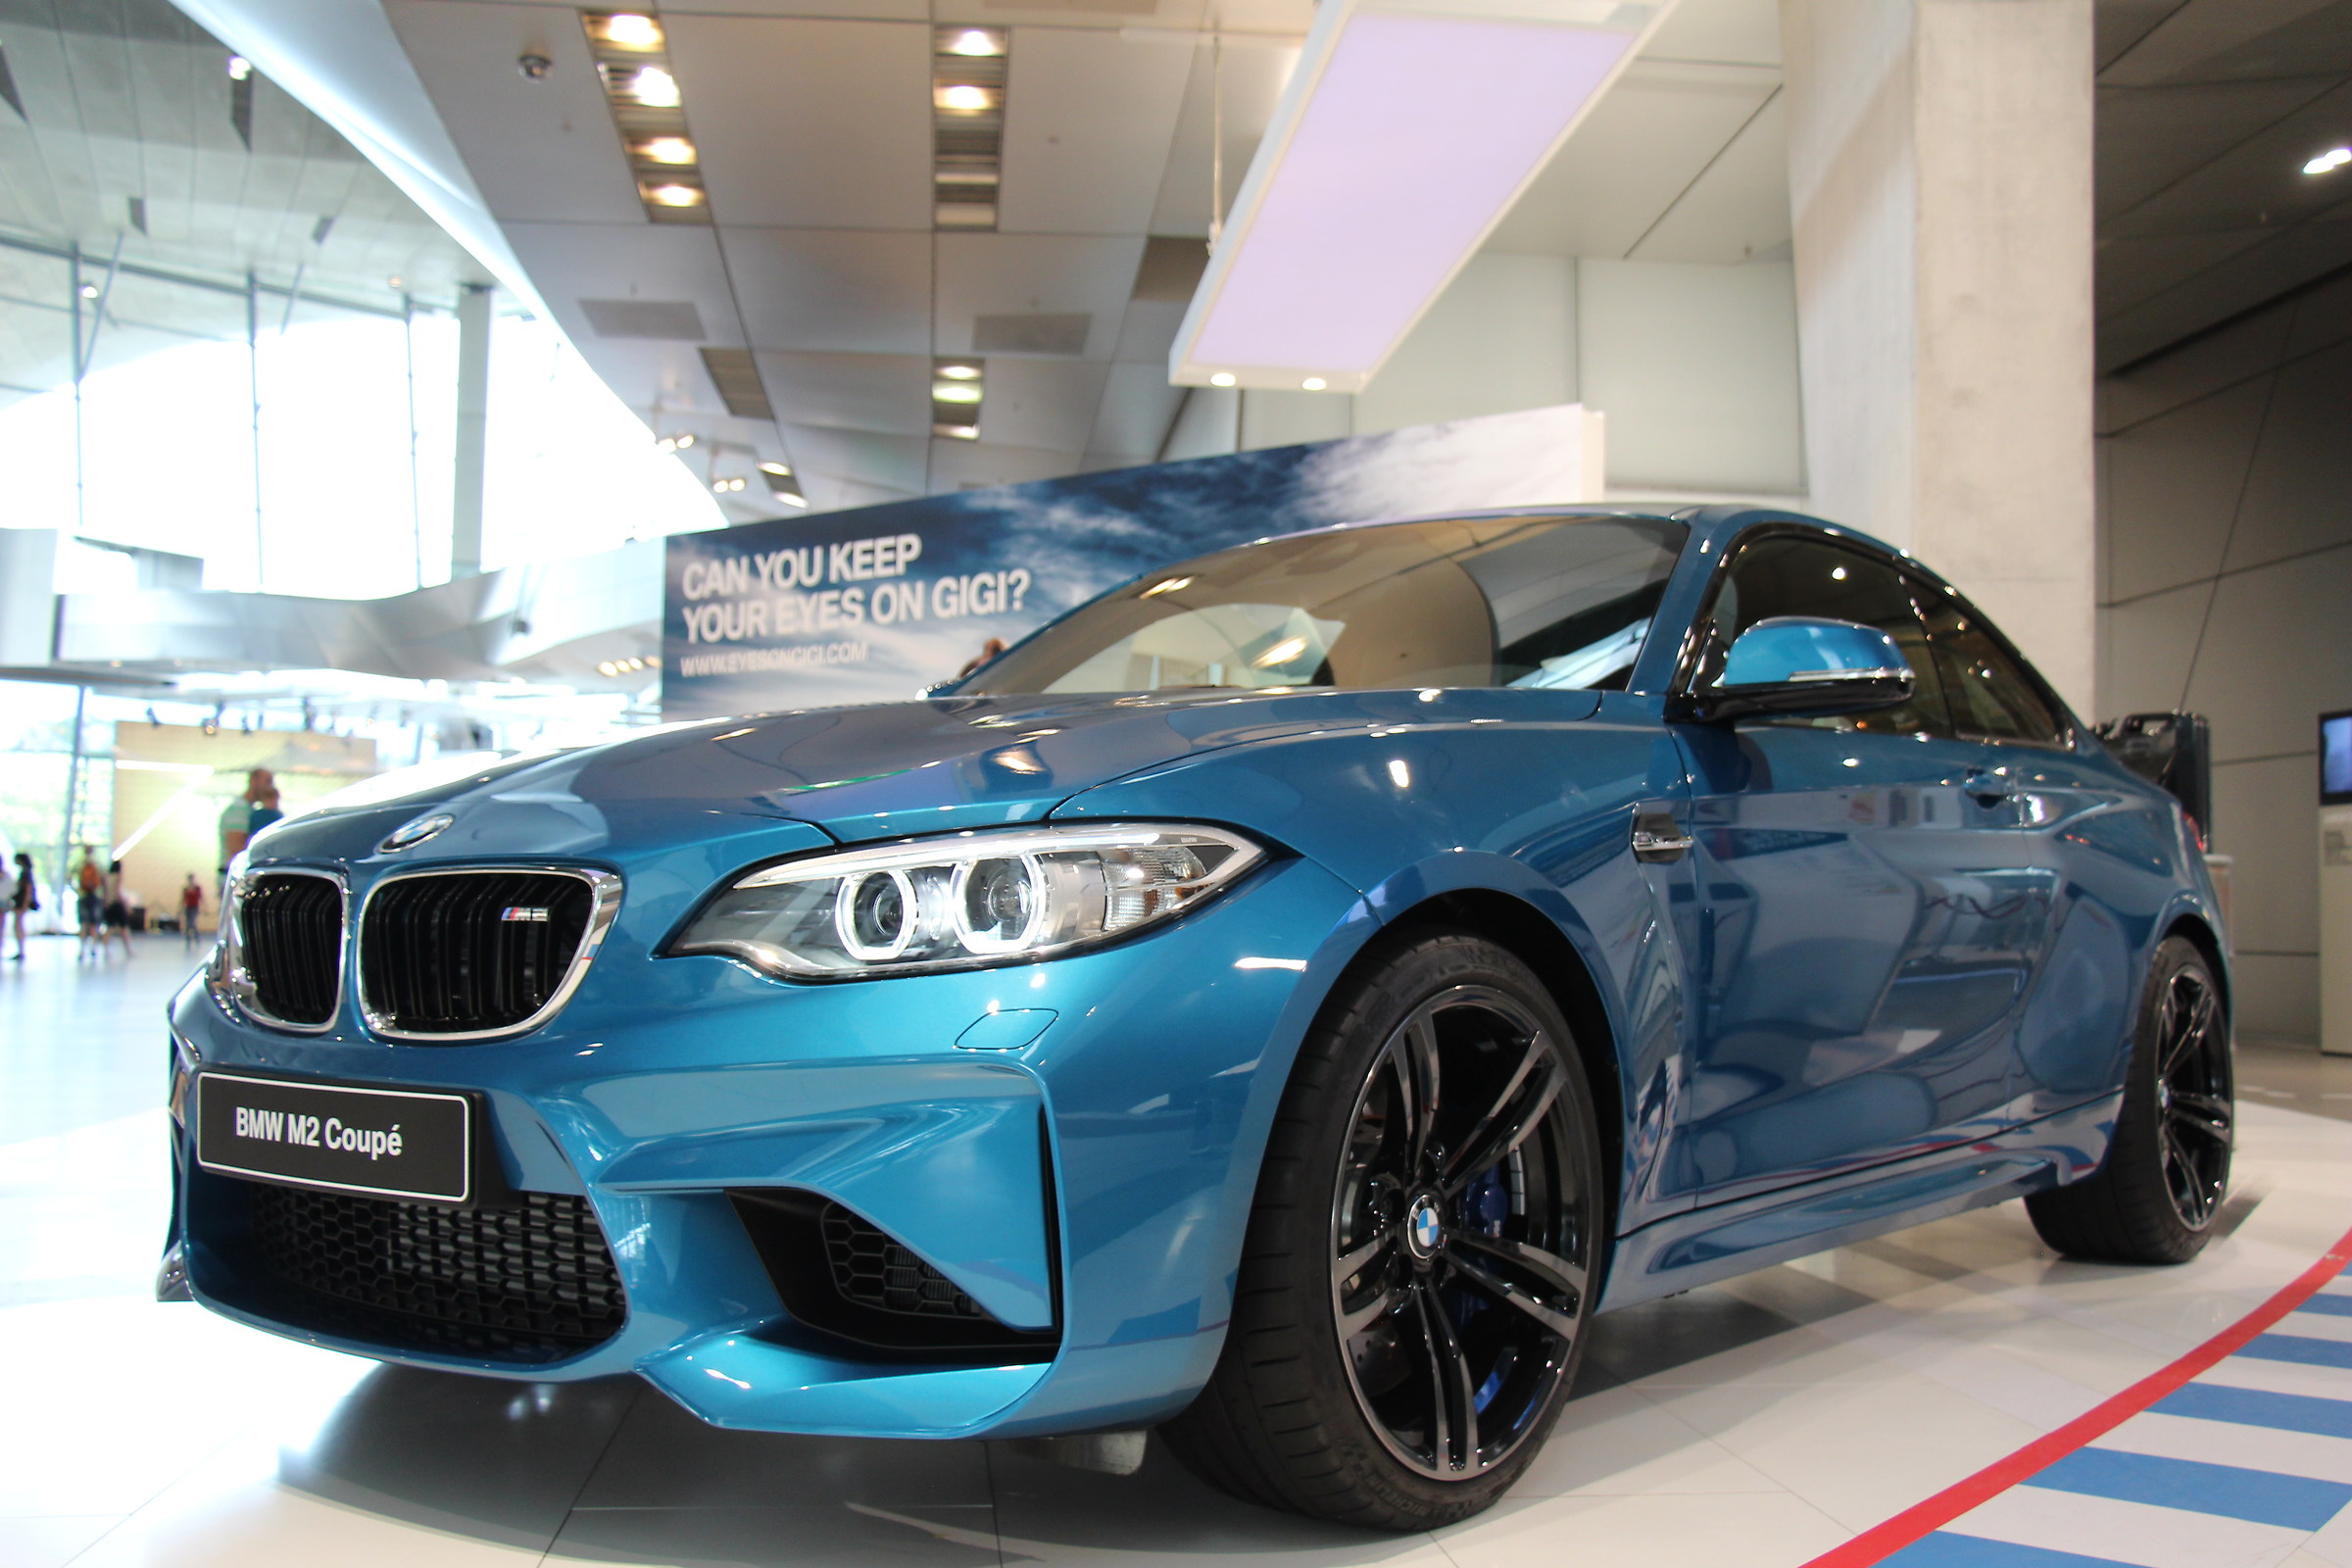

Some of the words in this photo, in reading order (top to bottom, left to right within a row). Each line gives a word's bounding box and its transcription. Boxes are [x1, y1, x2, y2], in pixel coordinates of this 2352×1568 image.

[681, 556, 750, 602] CAN
[754, 545, 825, 588] YOU
[829, 533, 922, 583] KEEP
[681, 601, 768, 645] YOUR
[775, 588, 864, 635] EYES
[870, 581, 925, 625] ON
[931, 568, 1031, 618] GIGI?
[680, 641, 868, 677] WWW.EYESONGIGI.COM
[235, 1106, 284, 1143] BMW
[288, 1113, 319, 1148] M2
[324, 1117, 403, 1160] Coupé
[1363, 1473, 1434, 1518] MICHELIN
